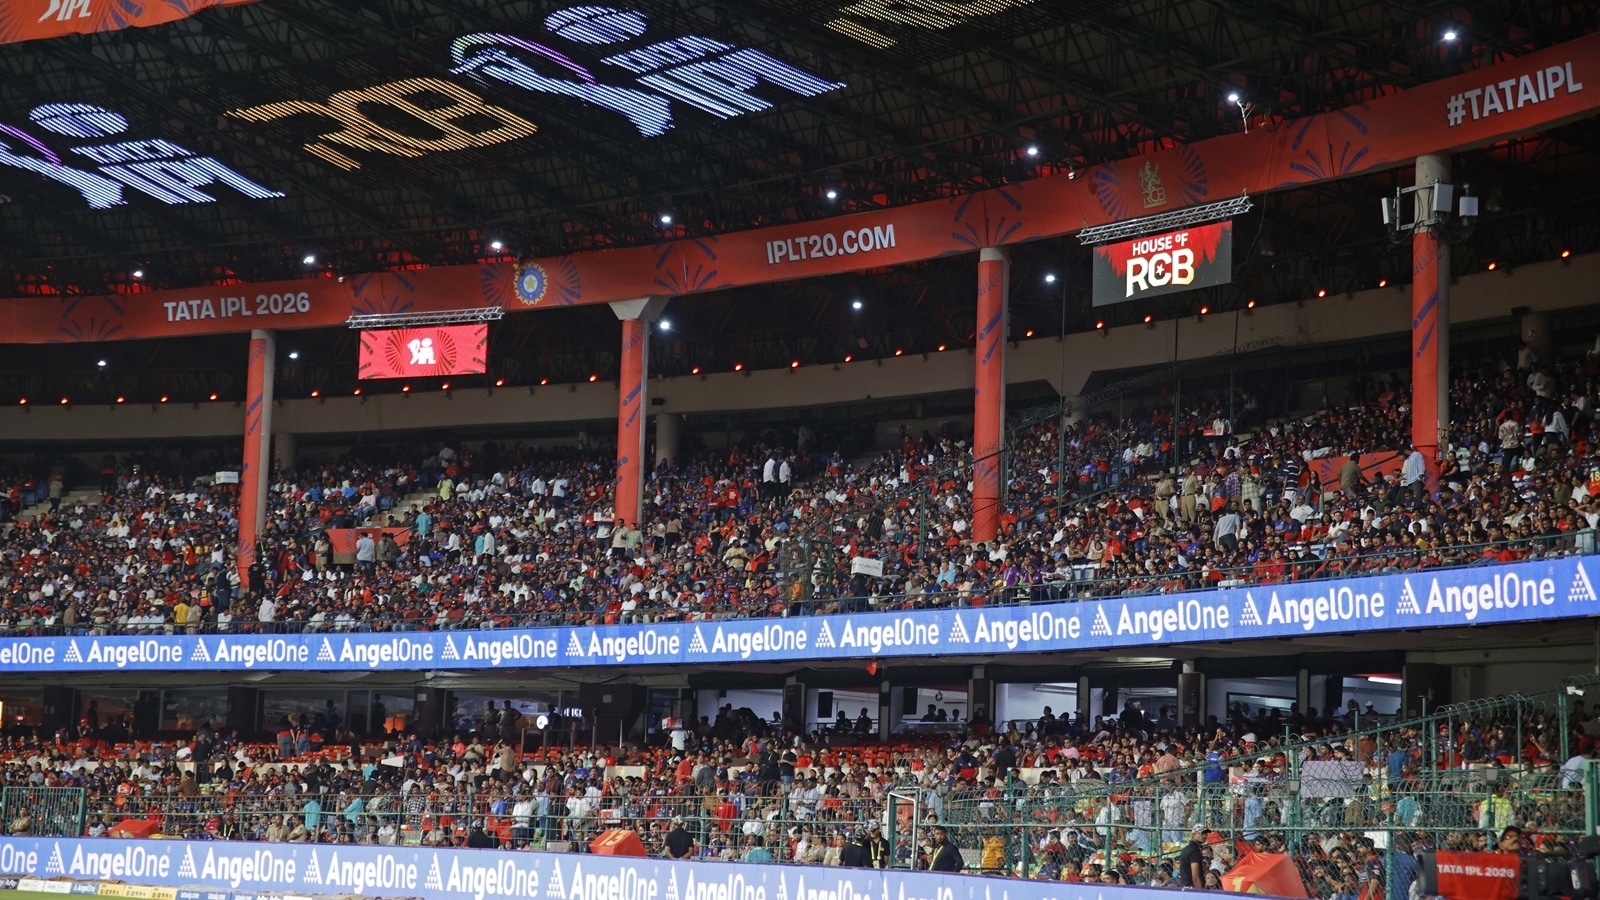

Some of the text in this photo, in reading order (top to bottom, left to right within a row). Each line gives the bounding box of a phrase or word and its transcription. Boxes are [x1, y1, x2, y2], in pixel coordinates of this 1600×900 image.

[1447, 62, 1583, 127] #TATAIPL
[766, 224, 896, 264] IPLT20.COM
[1132, 233, 1189, 256] HOUSE OF
[1126, 248, 1194, 298] RCB
[164, 292, 310, 322] TATA IPL 2026
[1266, 586, 1385, 630] AngelOne
[1425, 572, 1555, 620] AngelOne
[840, 617, 939, 653] AngelOne
[974, 611, 1080, 649] AngelOne
[1117, 600, 1229, 642] AngelOne
[0, 642, 55, 664] elOne
[87, 640, 182, 667] AngelOne
[214, 639, 308, 667] AngelOne
[339, 638, 434, 668] AngelOne
[463, 634, 557, 665] AngelOne
[588, 630, 679, 662] AngelOne
[712, 625, 806, 658] AngelOne
[0, 843, 38, 874] One
[69, 843, 170, 879] AngelOne
[201, 846, 296, 888] AngelOne
[326, 851, 418, 895] AngelOne
[1437, 864, 1515, 878] TATA IPL 2026
[447, 855, 539, 900] AngelOne
[569, 861, 658, 900] AngelOne
